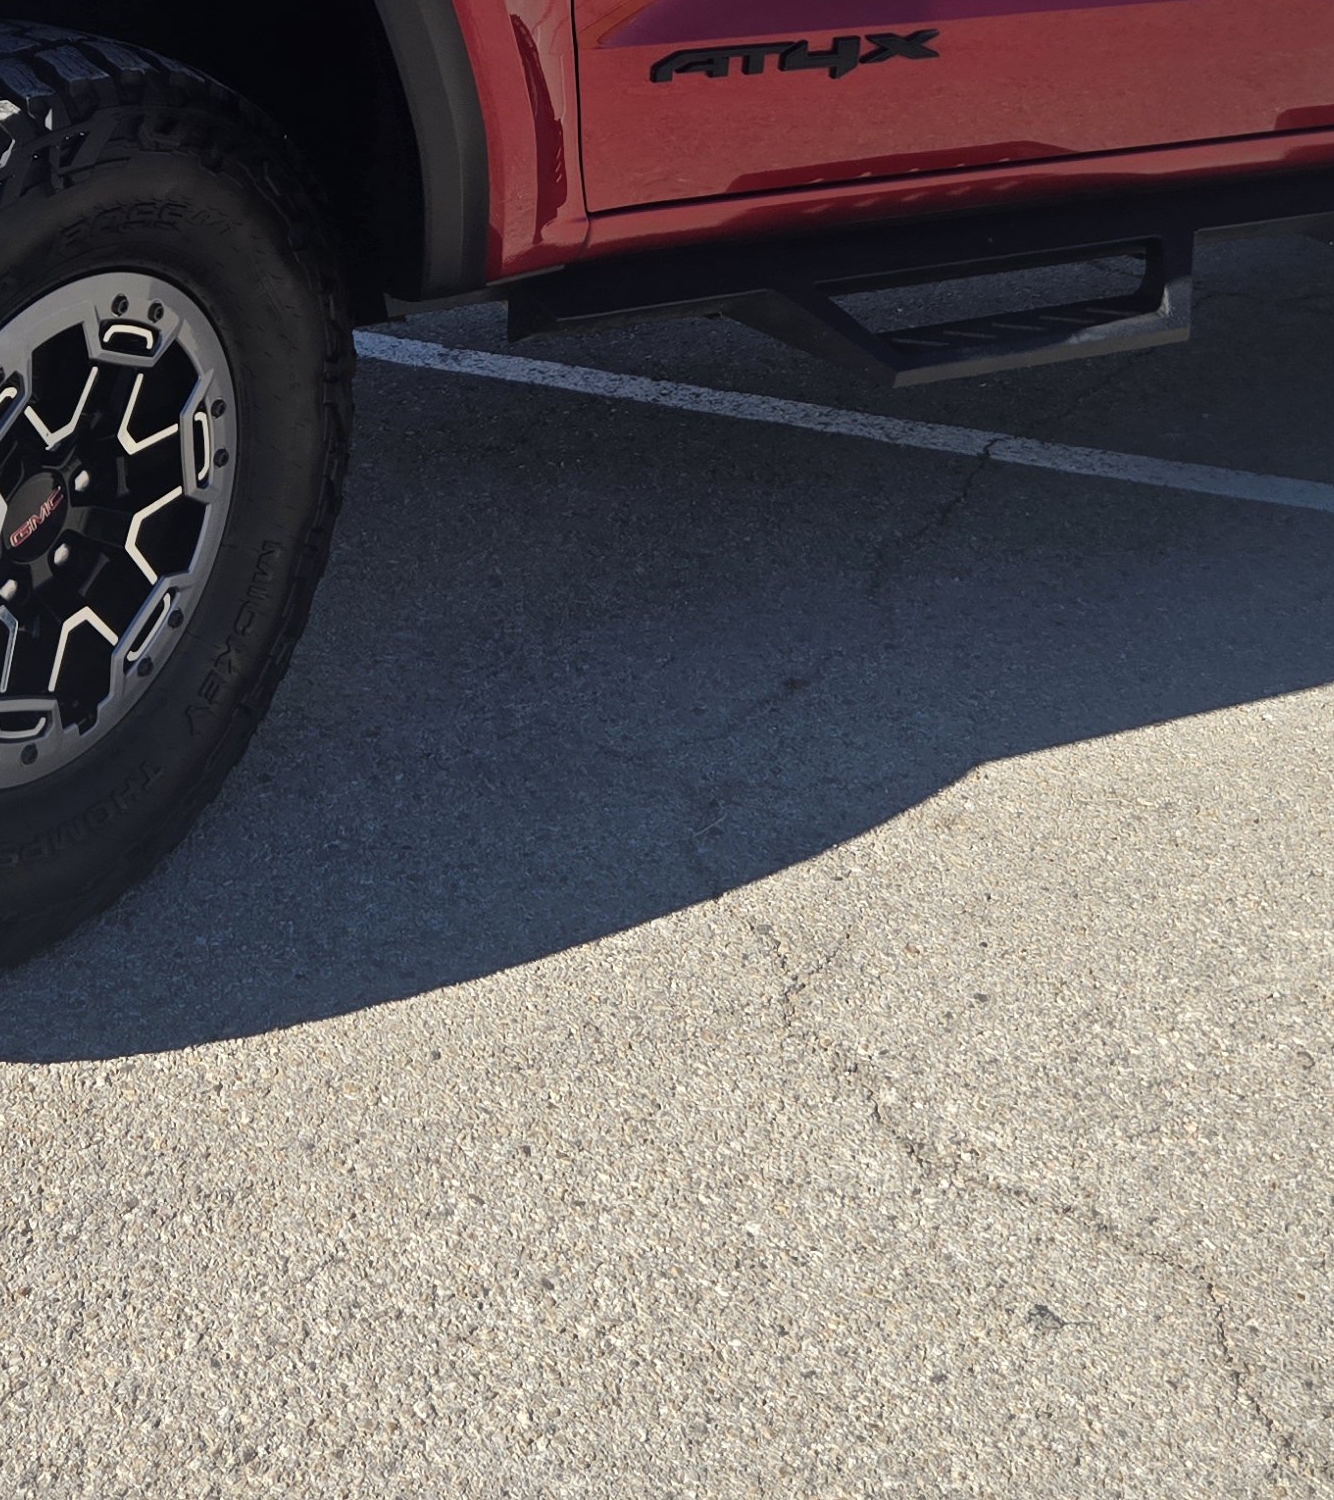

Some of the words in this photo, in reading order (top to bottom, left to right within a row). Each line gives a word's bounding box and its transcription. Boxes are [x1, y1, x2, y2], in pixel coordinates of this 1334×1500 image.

[649, 29, 940, 84] AT4X
[10, 485, 64, 547] GMC
[183, 539, 283, 737] MICKEY
